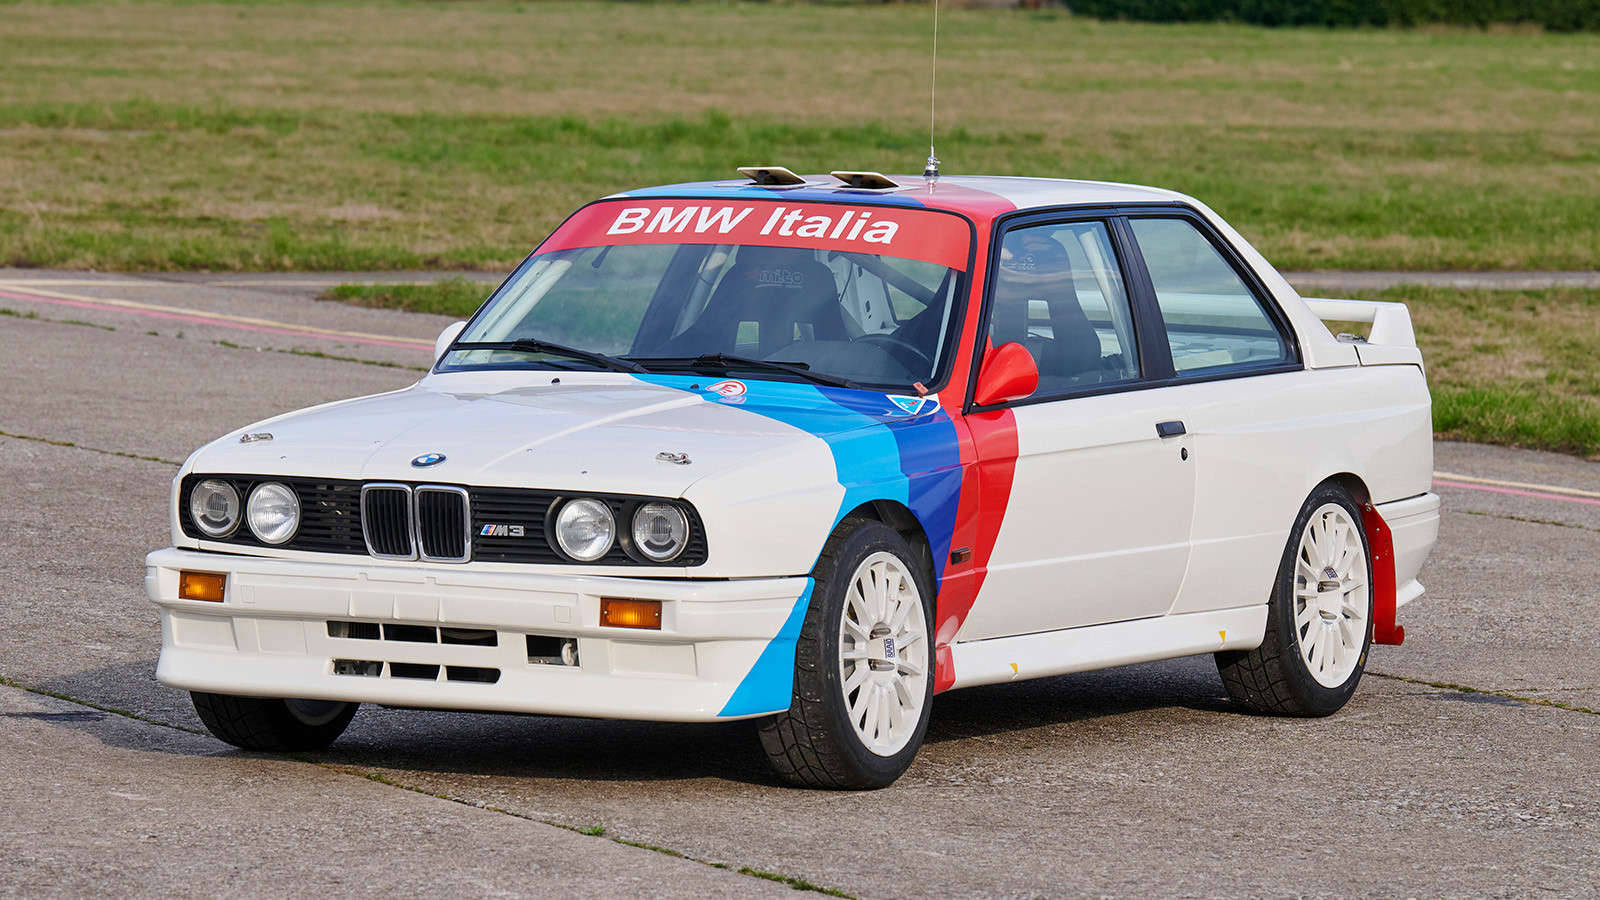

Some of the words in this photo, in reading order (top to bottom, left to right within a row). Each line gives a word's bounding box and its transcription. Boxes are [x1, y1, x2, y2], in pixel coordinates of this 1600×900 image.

[606, 206, 755, 235] BMW
[759, 207, 899, 244] Italia
[492, 524, 525, 537] M3
